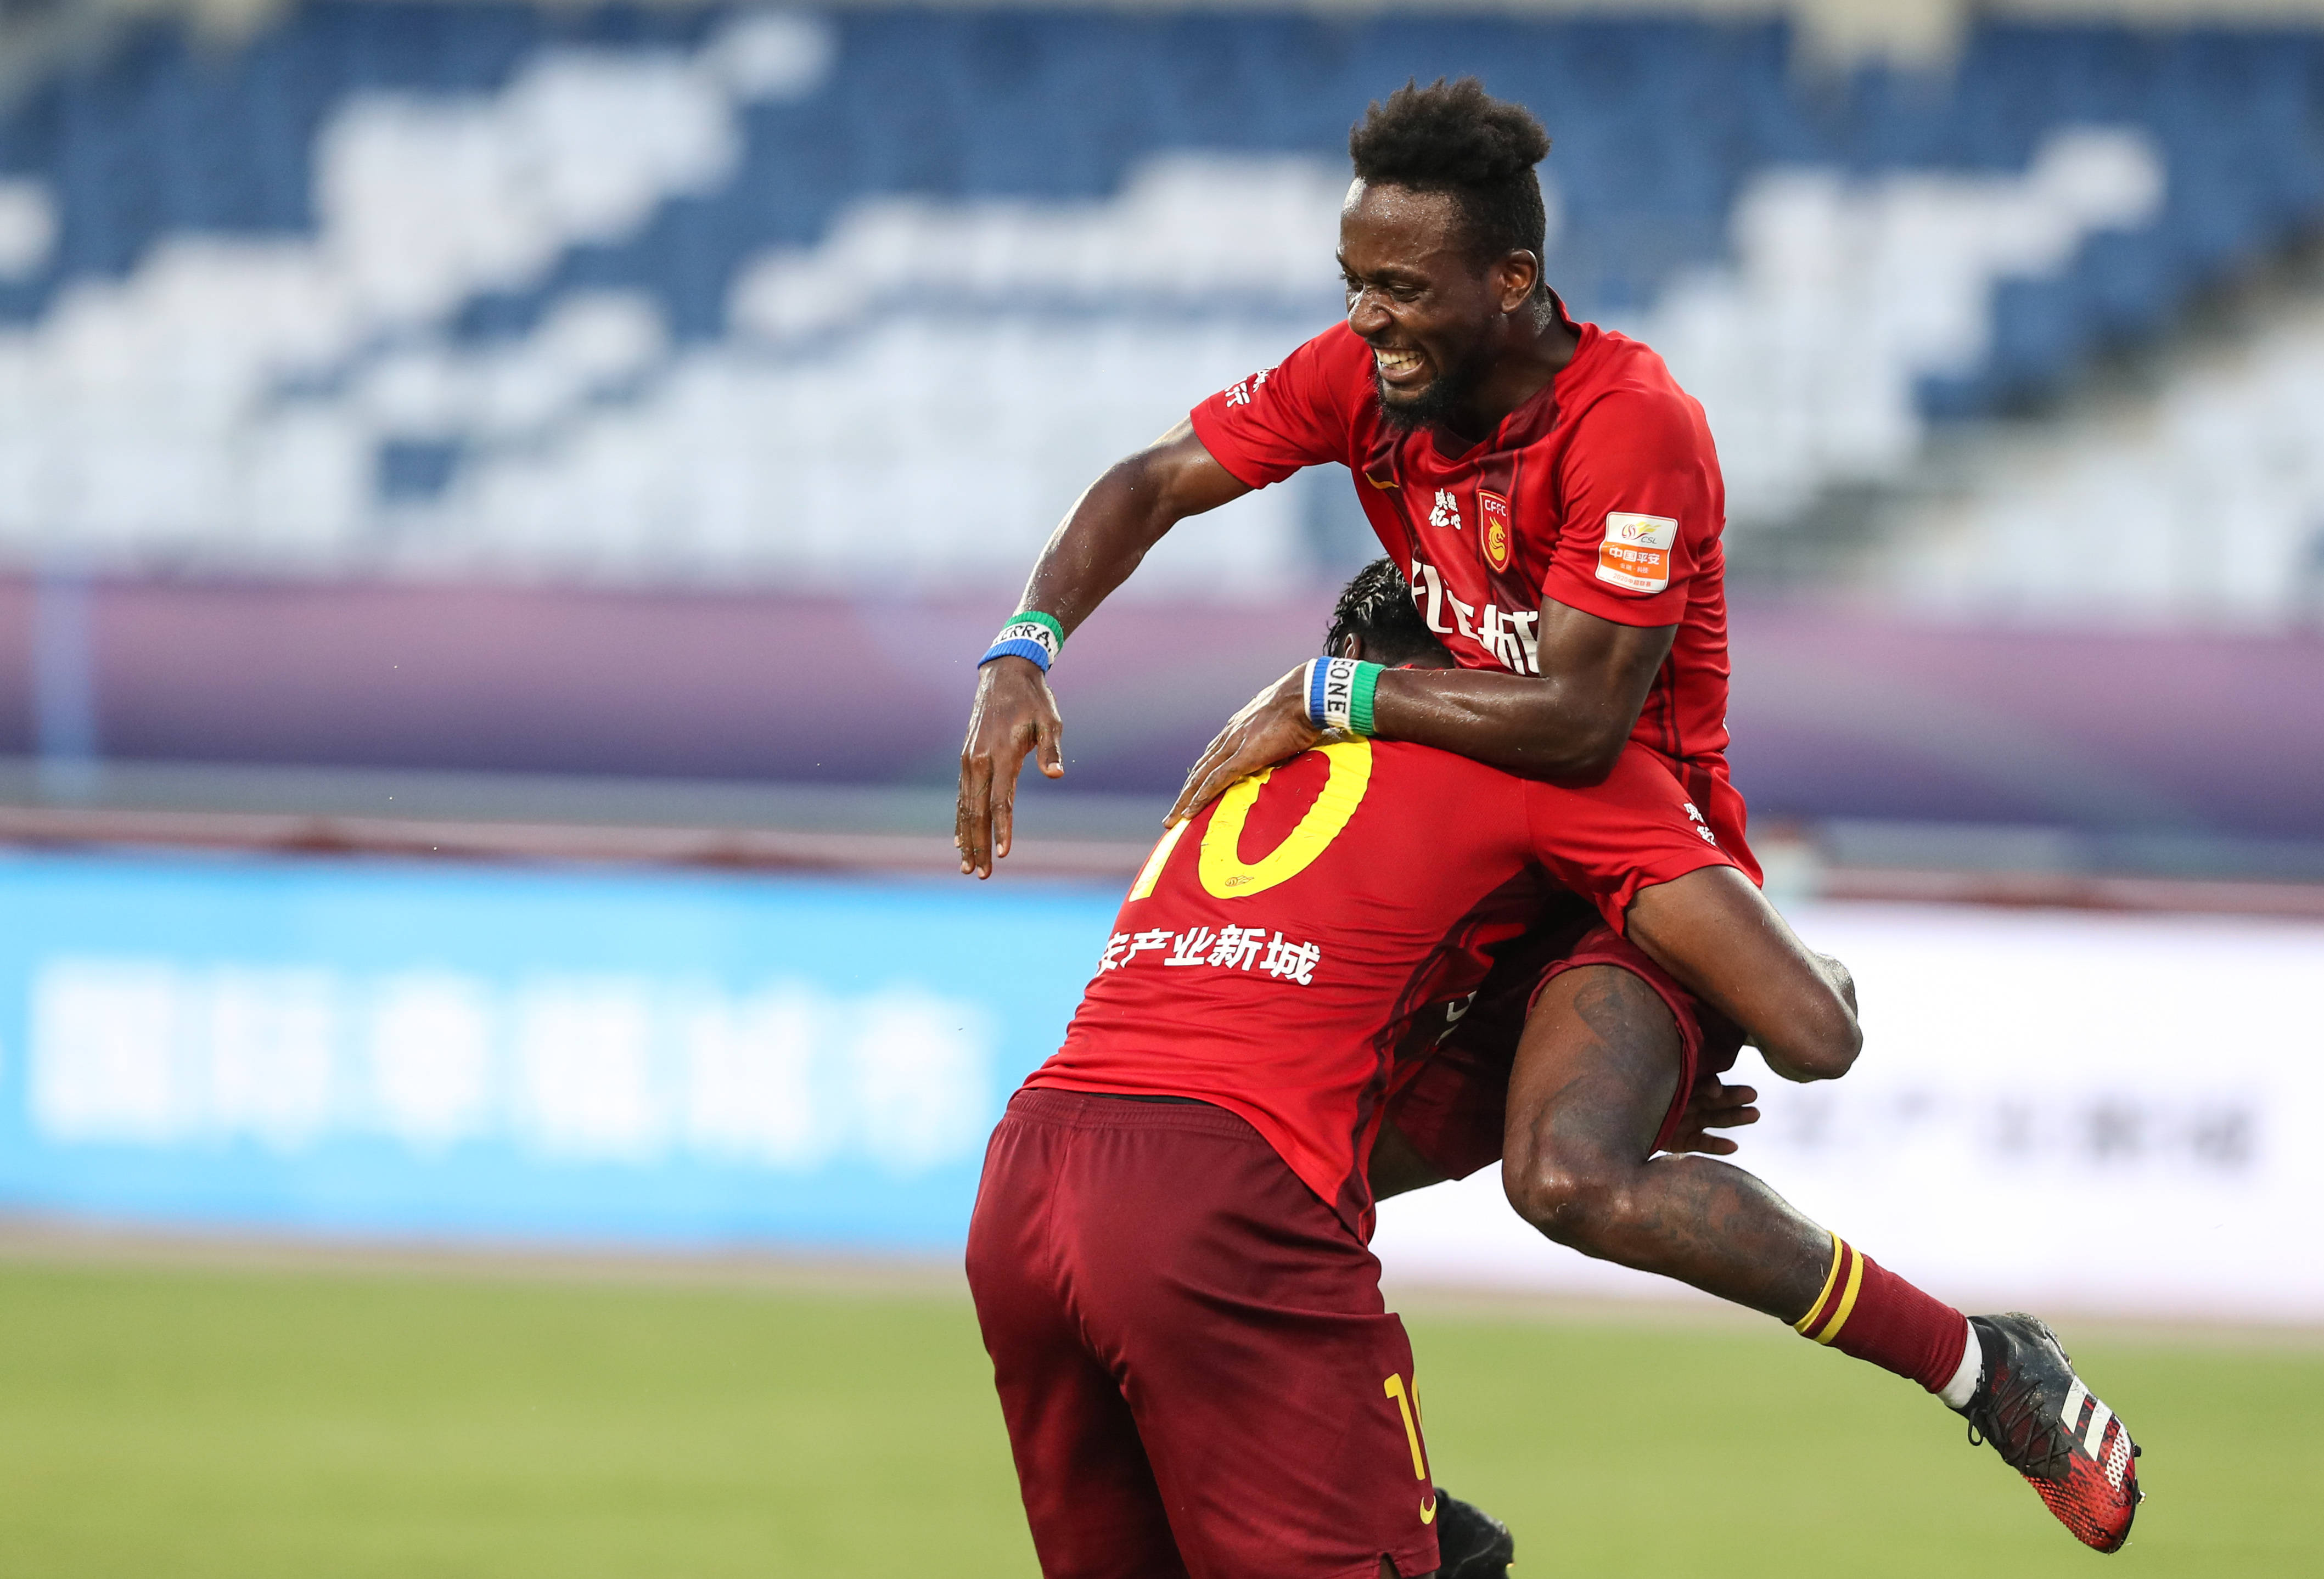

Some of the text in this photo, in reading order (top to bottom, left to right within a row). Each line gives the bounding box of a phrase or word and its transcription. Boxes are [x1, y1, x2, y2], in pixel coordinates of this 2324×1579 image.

[1485, 499, 1506, 516] CFFC
[1641, 536, 1657, 544] CSL
[1609, 547, 1660, 565] 中国平安
[995, 625, 1049, 648] ERRA
